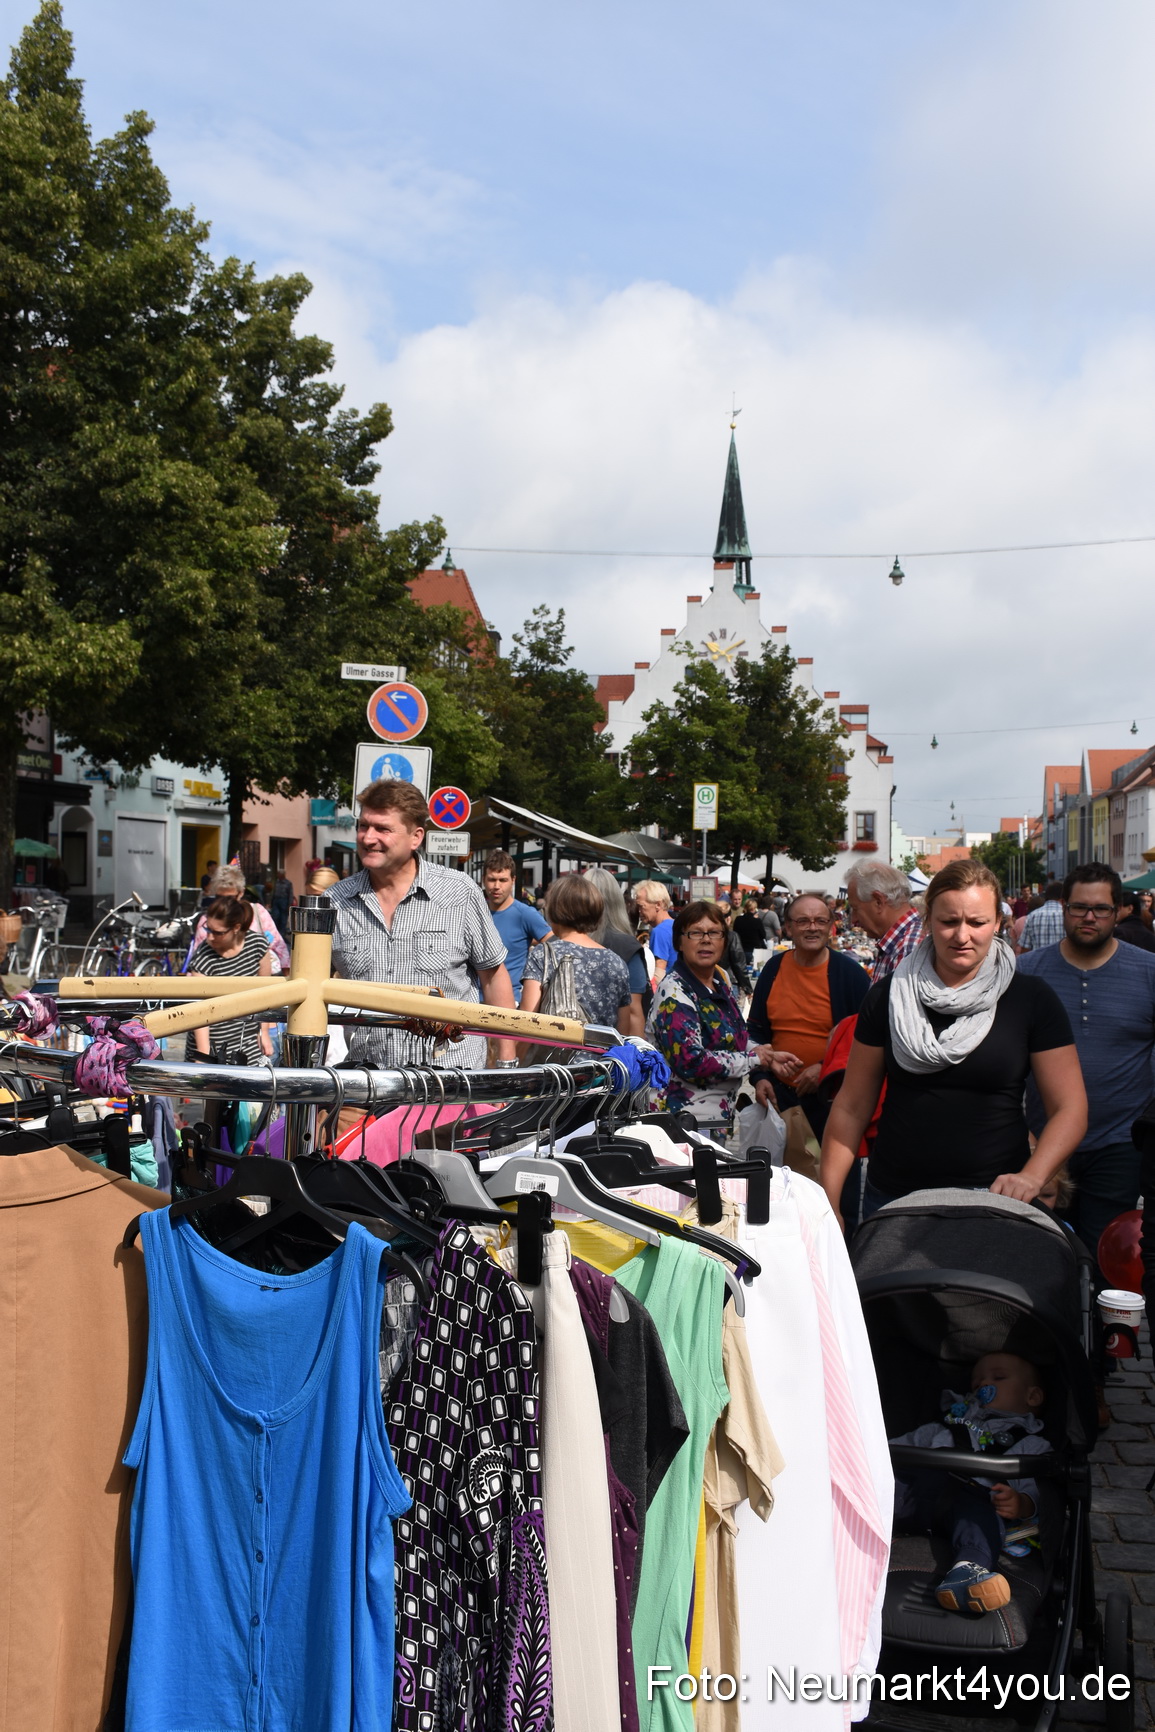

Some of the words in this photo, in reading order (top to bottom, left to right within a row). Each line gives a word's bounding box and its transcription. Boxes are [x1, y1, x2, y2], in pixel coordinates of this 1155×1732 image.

[345, 666, 369, 676] Ulmer
[371, 667, 395, 678] Gasse
[431, 835, 466, 843] Feuerwehr-
[437, 844, 459, 852] zufahrt
